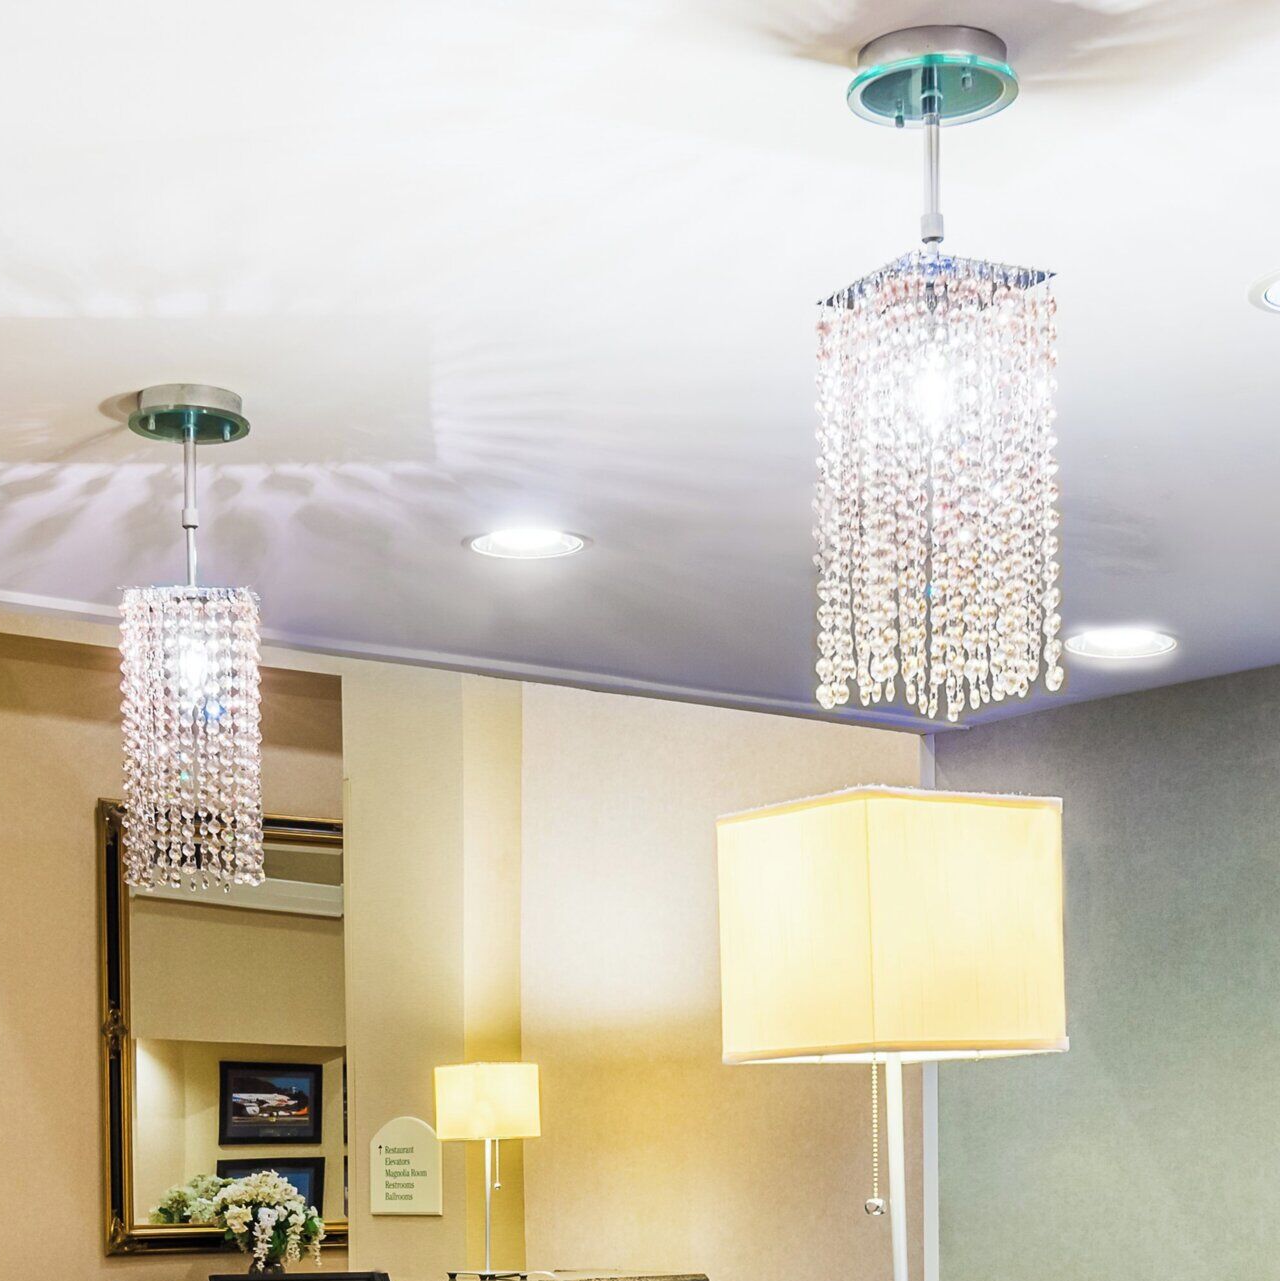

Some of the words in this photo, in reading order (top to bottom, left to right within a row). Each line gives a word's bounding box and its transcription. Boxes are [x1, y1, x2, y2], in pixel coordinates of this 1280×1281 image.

[385, 1145, 414, 1154] Restaurant
[385, 1157, 410, 1166] Elevators
[385, 1168, 410, 1179] Magnolia
[410, 1168, 428, 1177] Room
[385, 1180, 415, 1189] Restrooms
[385, 1192, 413, 1201] Ballrooms
